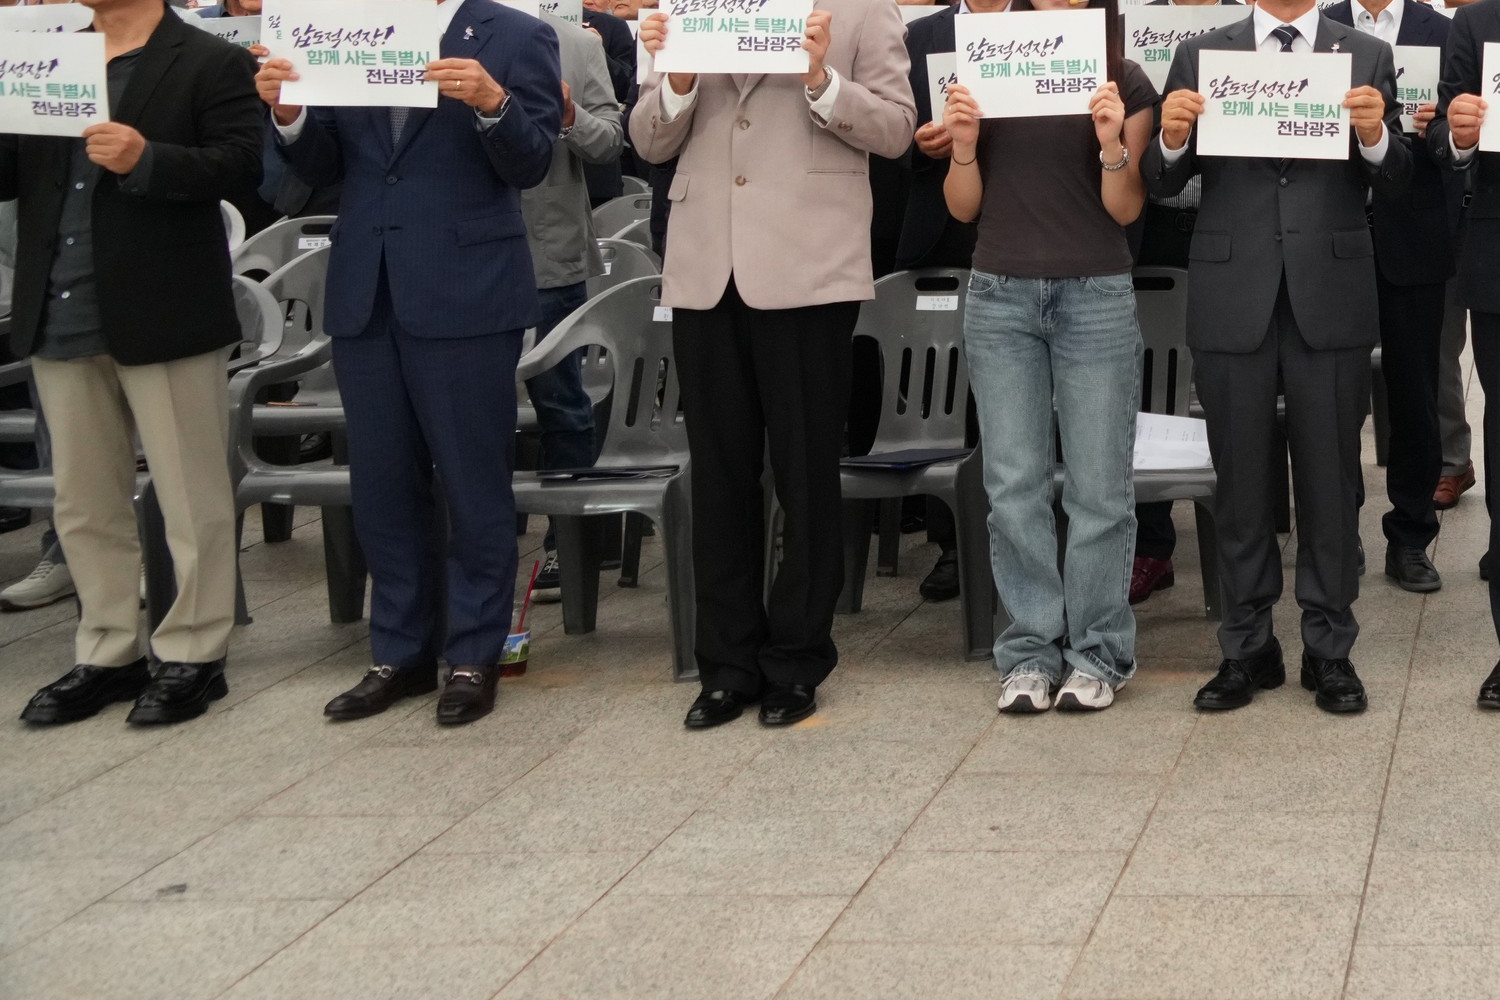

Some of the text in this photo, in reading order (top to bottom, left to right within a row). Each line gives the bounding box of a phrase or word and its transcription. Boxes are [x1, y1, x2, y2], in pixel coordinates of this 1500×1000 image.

[682, 17, 802, 34] 함께 사는 특별시
[291, 23, 344, 48] 압도적
[343, 25, 396, 47] 성장!
[737, 36, 802, 52] 전남광주
[1132, 27, 1175, 48] 압도적
[966, 35, 1064, 63] 압도적 성장!
[1144, 48, 1171, 62] 함께
[307, 50, 430, 67] 함께 사는 특별시
[8, 58, 60, 80] 성장!
[979, 59, 1097, 79] 함께 사는 특별시
[9, 82, 42, 98] 사는
[45, 83, 97, 100] 특별시
[1035, 77, 1097, 95] 전남광주
[1209, 75, 1309, 100] 압도적 성장!
[31, 101, 97, 118] 전남광주
[1222, 100, 1341, 119] 함께 사는 특별시
[1277, 120, 1340, 137] 전남광주
